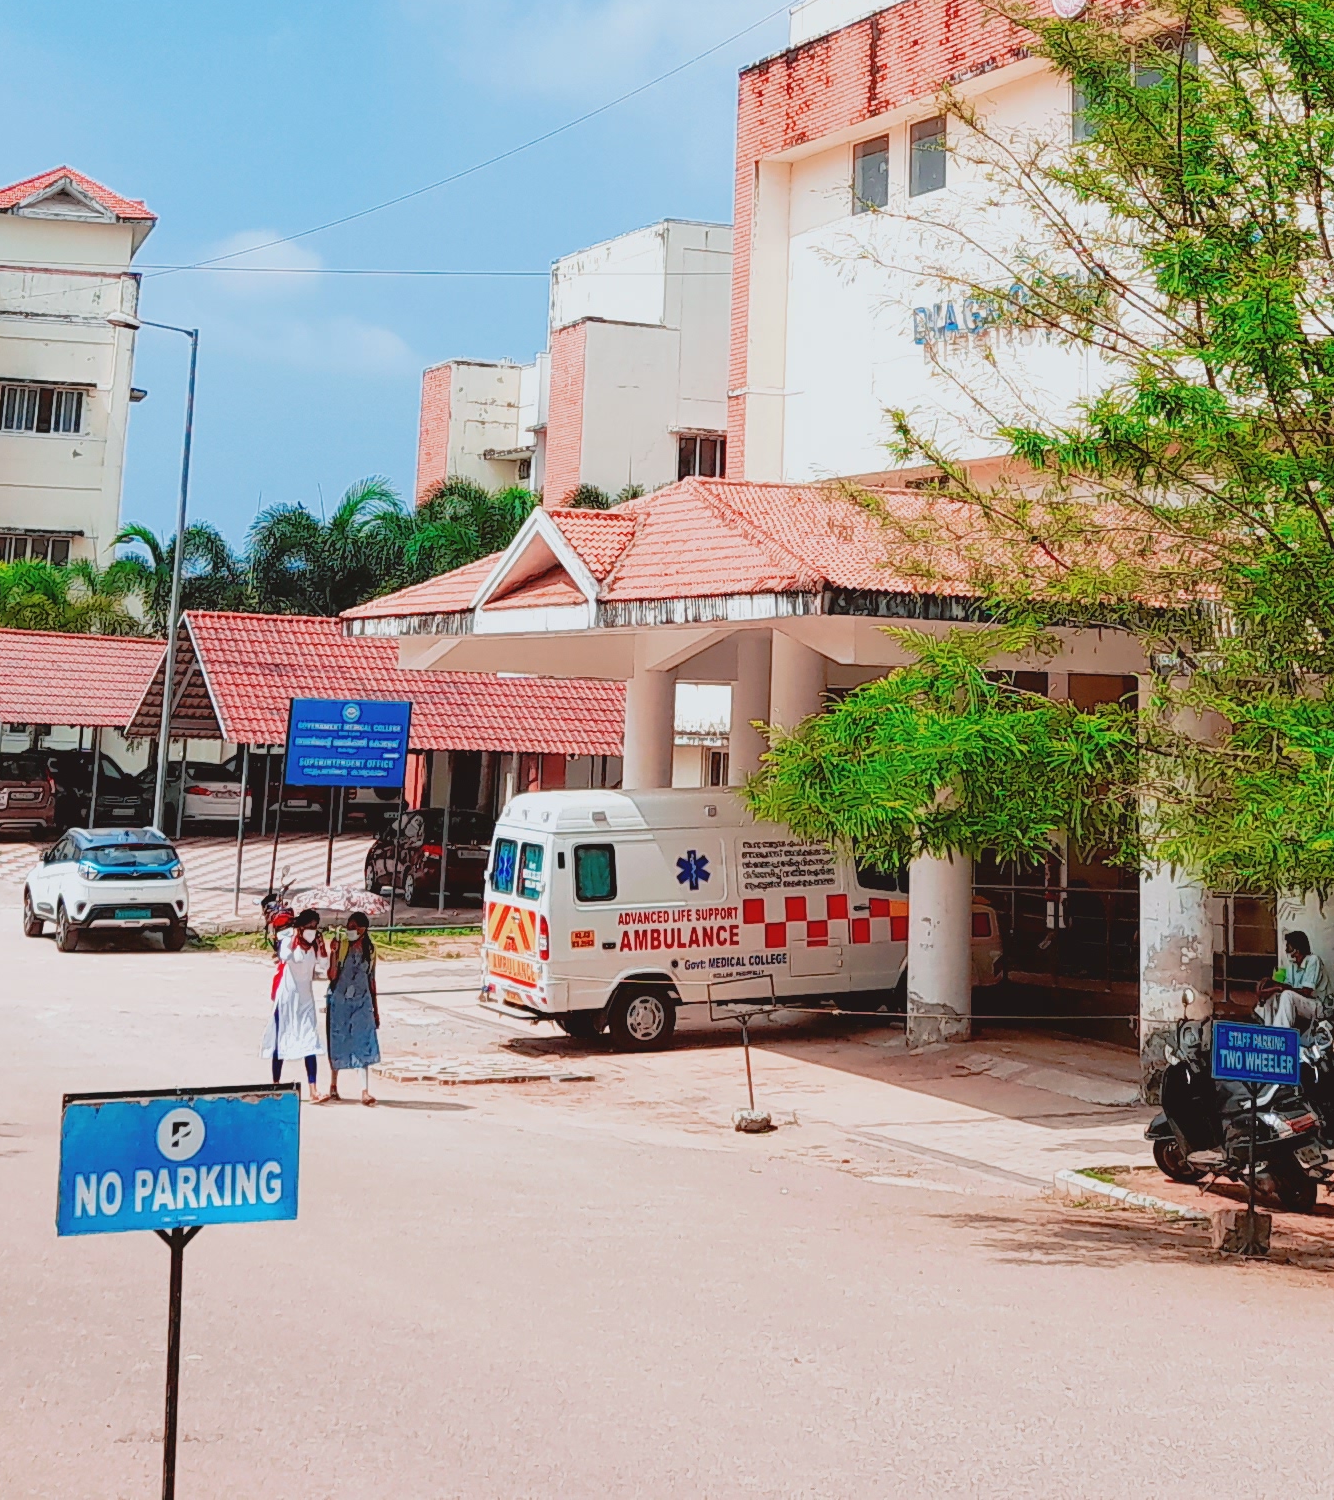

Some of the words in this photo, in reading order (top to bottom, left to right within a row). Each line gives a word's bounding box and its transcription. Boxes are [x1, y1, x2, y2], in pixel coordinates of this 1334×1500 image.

[367, 759, 394, 768] OFFICE
[618, 911, 669, 926] ADVANCED
[672, 909, 692, 923] LIFE
[695, 907, 739, 921] SUPPORT
[619, 924, 740, 952] AMBULANCE
[708, 956, 746, 969] MEDICAL
[748, 953, 787, 966] COLLEGE
[1228, 1031, 1251, 1048] STAFF
[1252, 1034, 1286, 1051] PARKING
[1219, 1049, 1243, 1070] TWO
[1245, 1051, 1294, 1075] WHEELER
[73, 1170, 123, 1219] NO
[134, 1160, 283, 1213] PARKING
